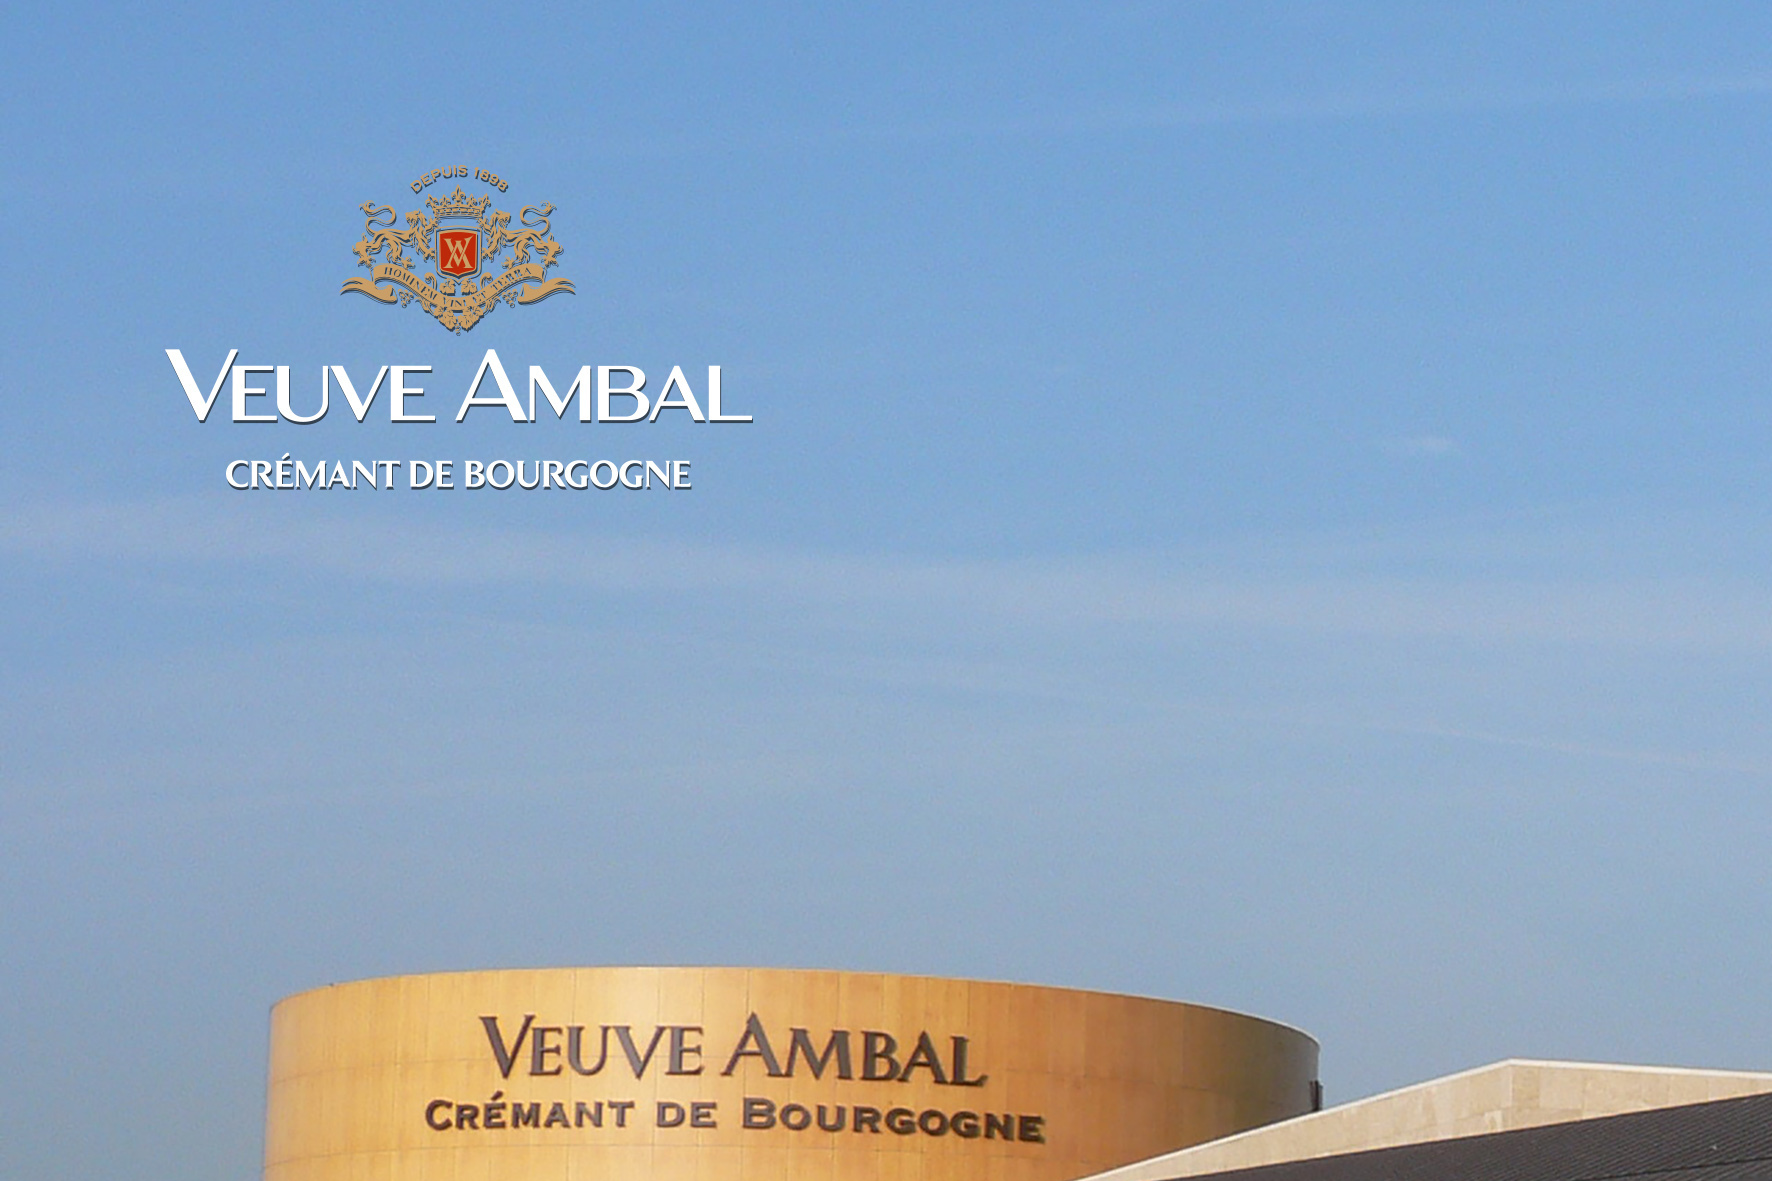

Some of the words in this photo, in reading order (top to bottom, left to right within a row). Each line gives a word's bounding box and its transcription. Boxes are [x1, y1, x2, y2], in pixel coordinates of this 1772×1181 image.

[479, 1013, 704, 1080] VEUVE
[720, 1012, 989, 1088] AMBAL
[425, 1091, 635, 1131] CRÉMANT
[655, 1100, 718, 1129] DE
[742, 1098, 1046, 1144] BOURGOGNE
